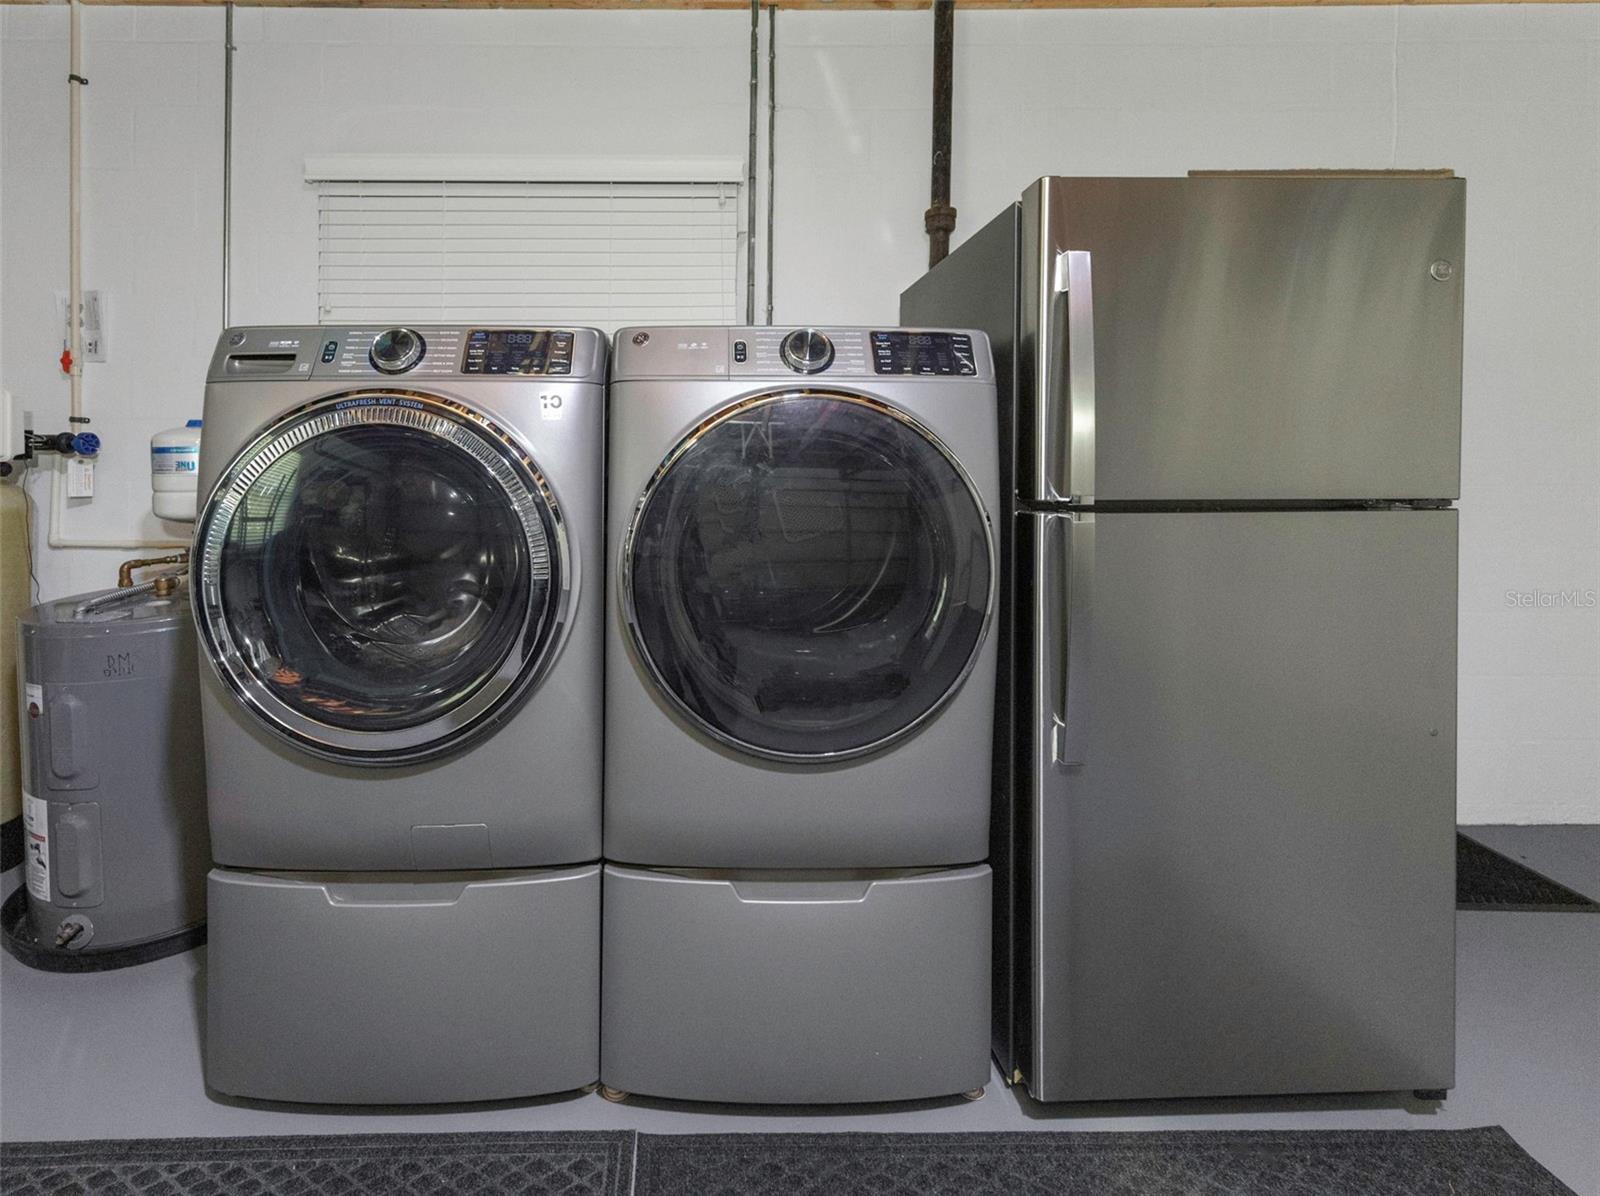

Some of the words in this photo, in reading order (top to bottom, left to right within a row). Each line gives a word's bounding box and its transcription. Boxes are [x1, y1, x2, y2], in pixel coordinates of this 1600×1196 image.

[335, 398, 377, 409] ULTRAFRESH
[379, 398, 396, 406] VENT
[399, 399, 424, 409] SYSTEM
